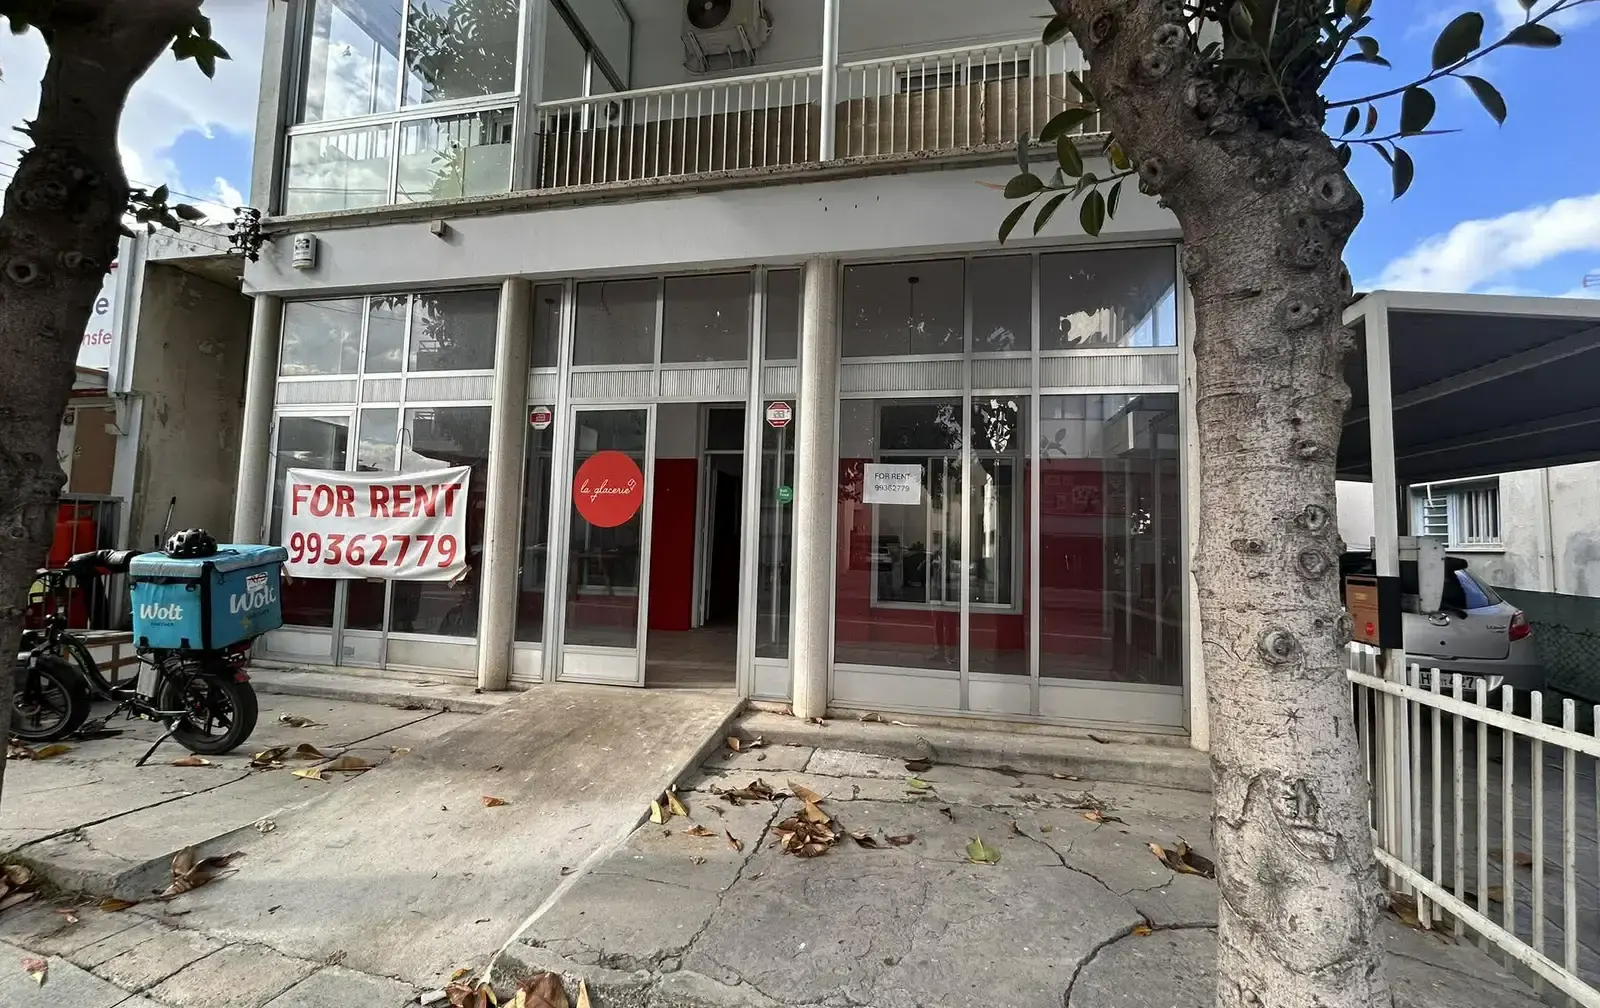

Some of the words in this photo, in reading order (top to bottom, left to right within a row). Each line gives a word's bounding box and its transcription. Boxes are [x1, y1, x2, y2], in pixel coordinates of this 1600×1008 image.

[95, 297, 109, 315] e
[82, 328, 112, 346] nsfe
[874, 472, 890, 480] FOR
[891, 472, 911, 480] RENT
[580, 478, 591, 494] la
[590, 478, 633, 503] glacerie
[292, 484, 355, 517] FOR
[369, 484, 461, 517] RENT
[290, 532, 457, 568] 99362779
[140, 602, 183, 620] Wolt
